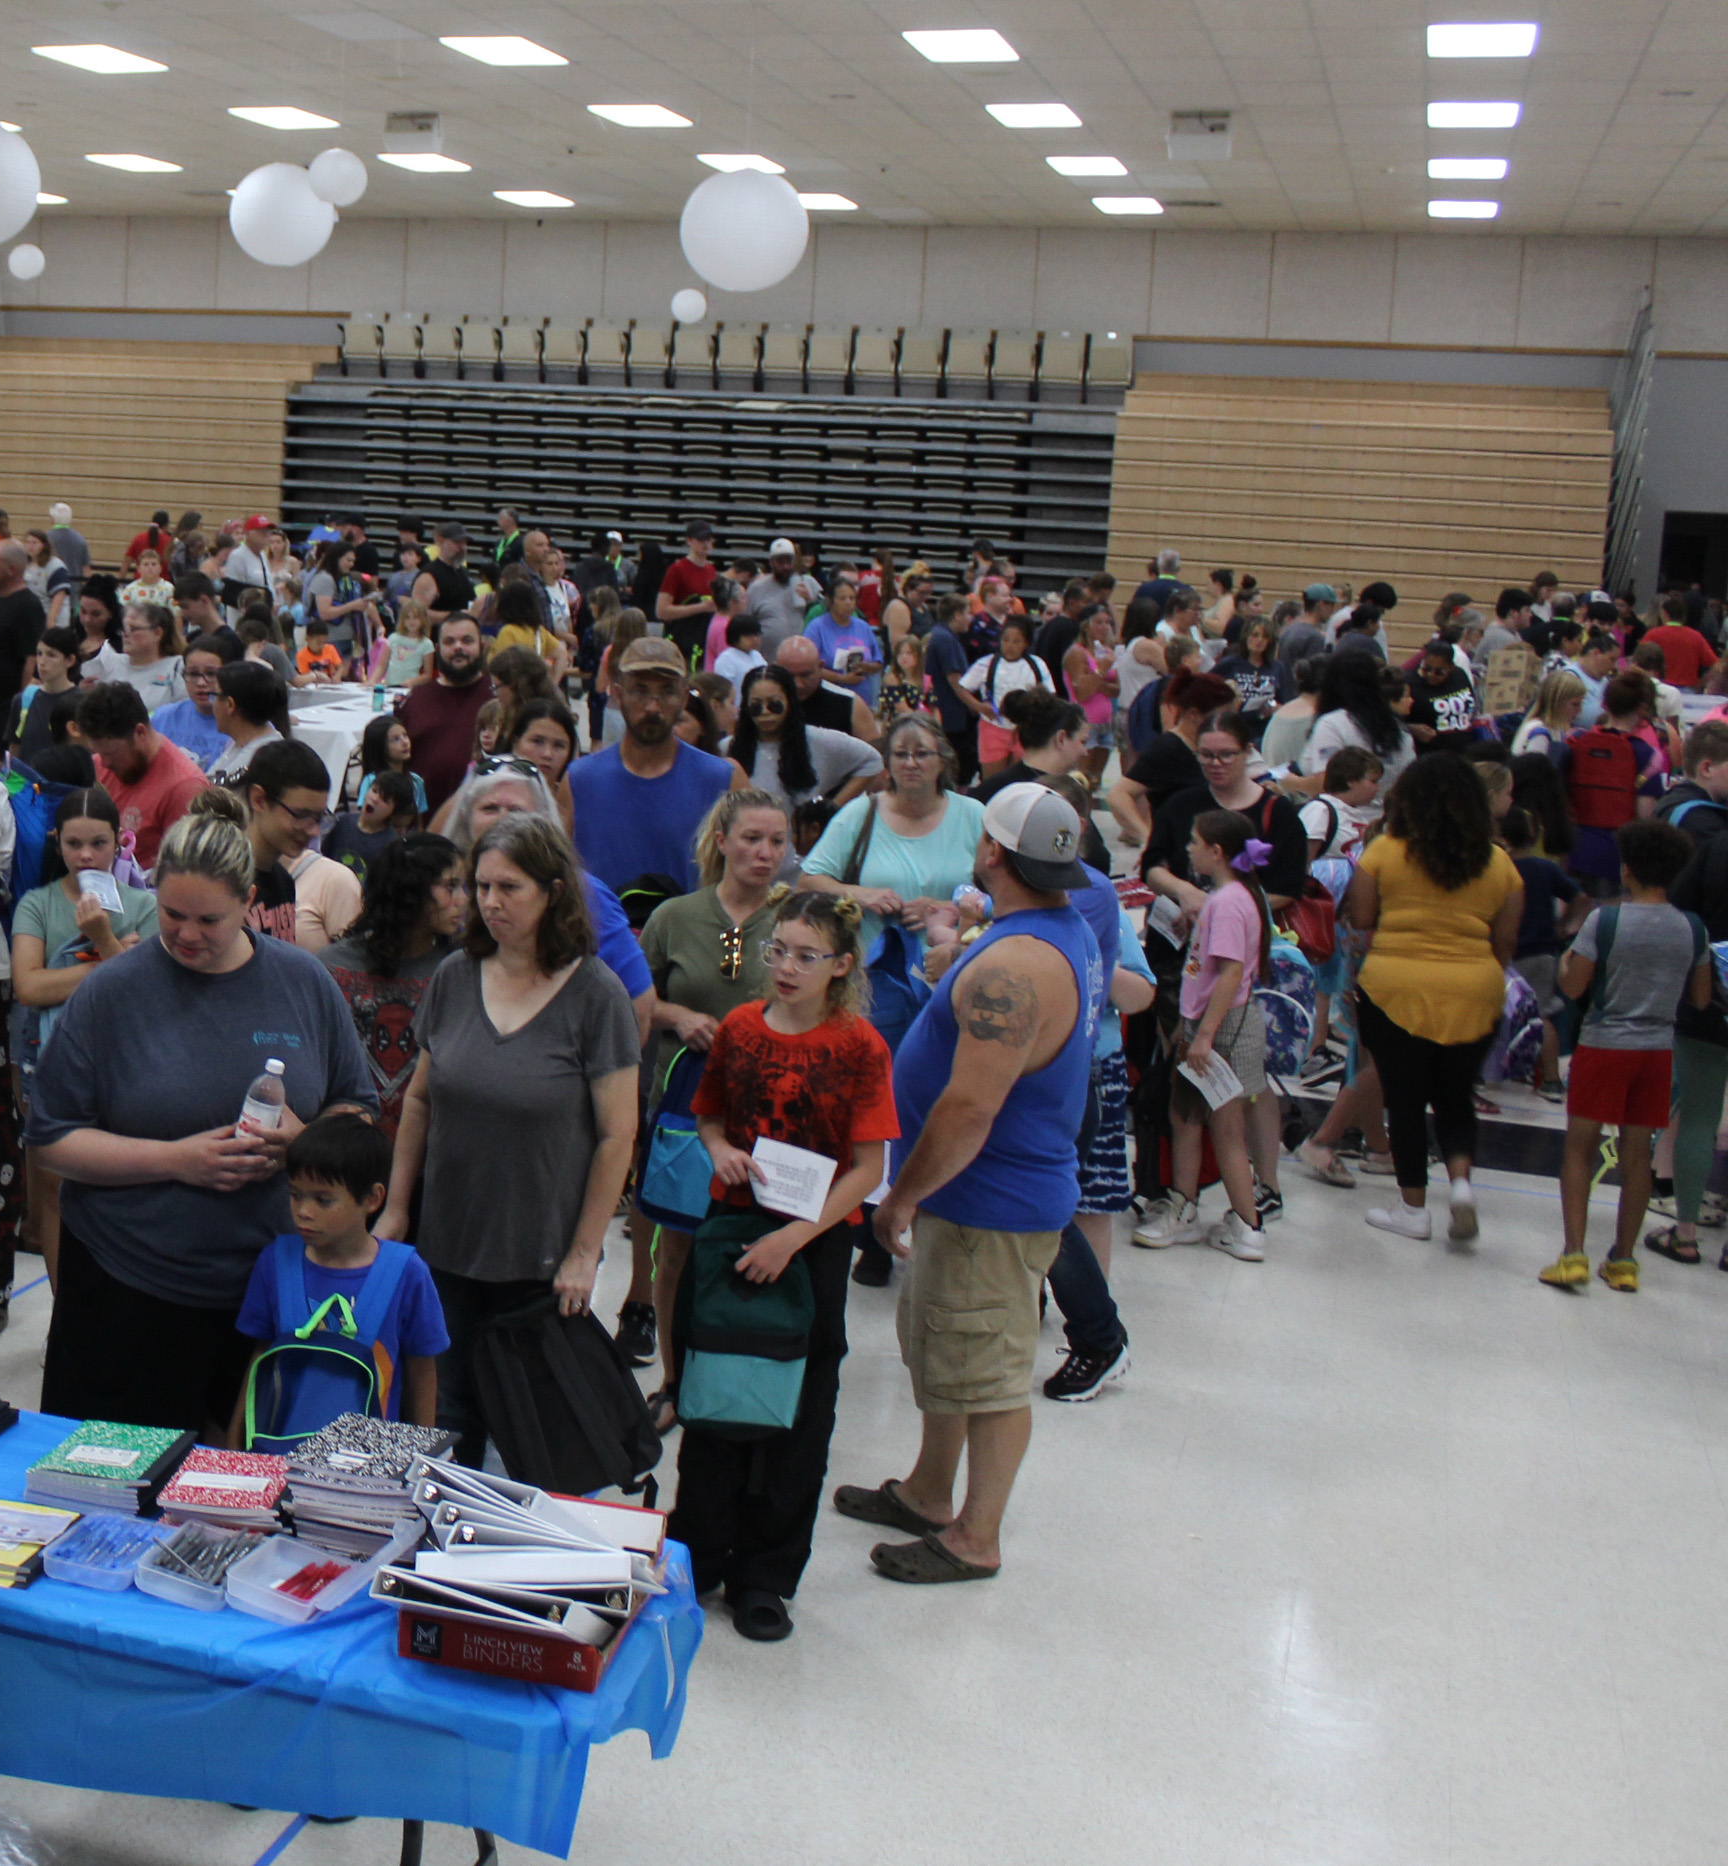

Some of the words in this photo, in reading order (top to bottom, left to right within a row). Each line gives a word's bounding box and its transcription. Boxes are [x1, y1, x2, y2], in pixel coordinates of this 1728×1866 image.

[464, 1632, 507, 1650] 1-INCH
[510, 1640, 544, 1656] VIEW
[463, 1645, 544, 1673] BINDERS
[573, 1652, 582, 1664] 8
[566, 1662, 587, 1673] PACK
